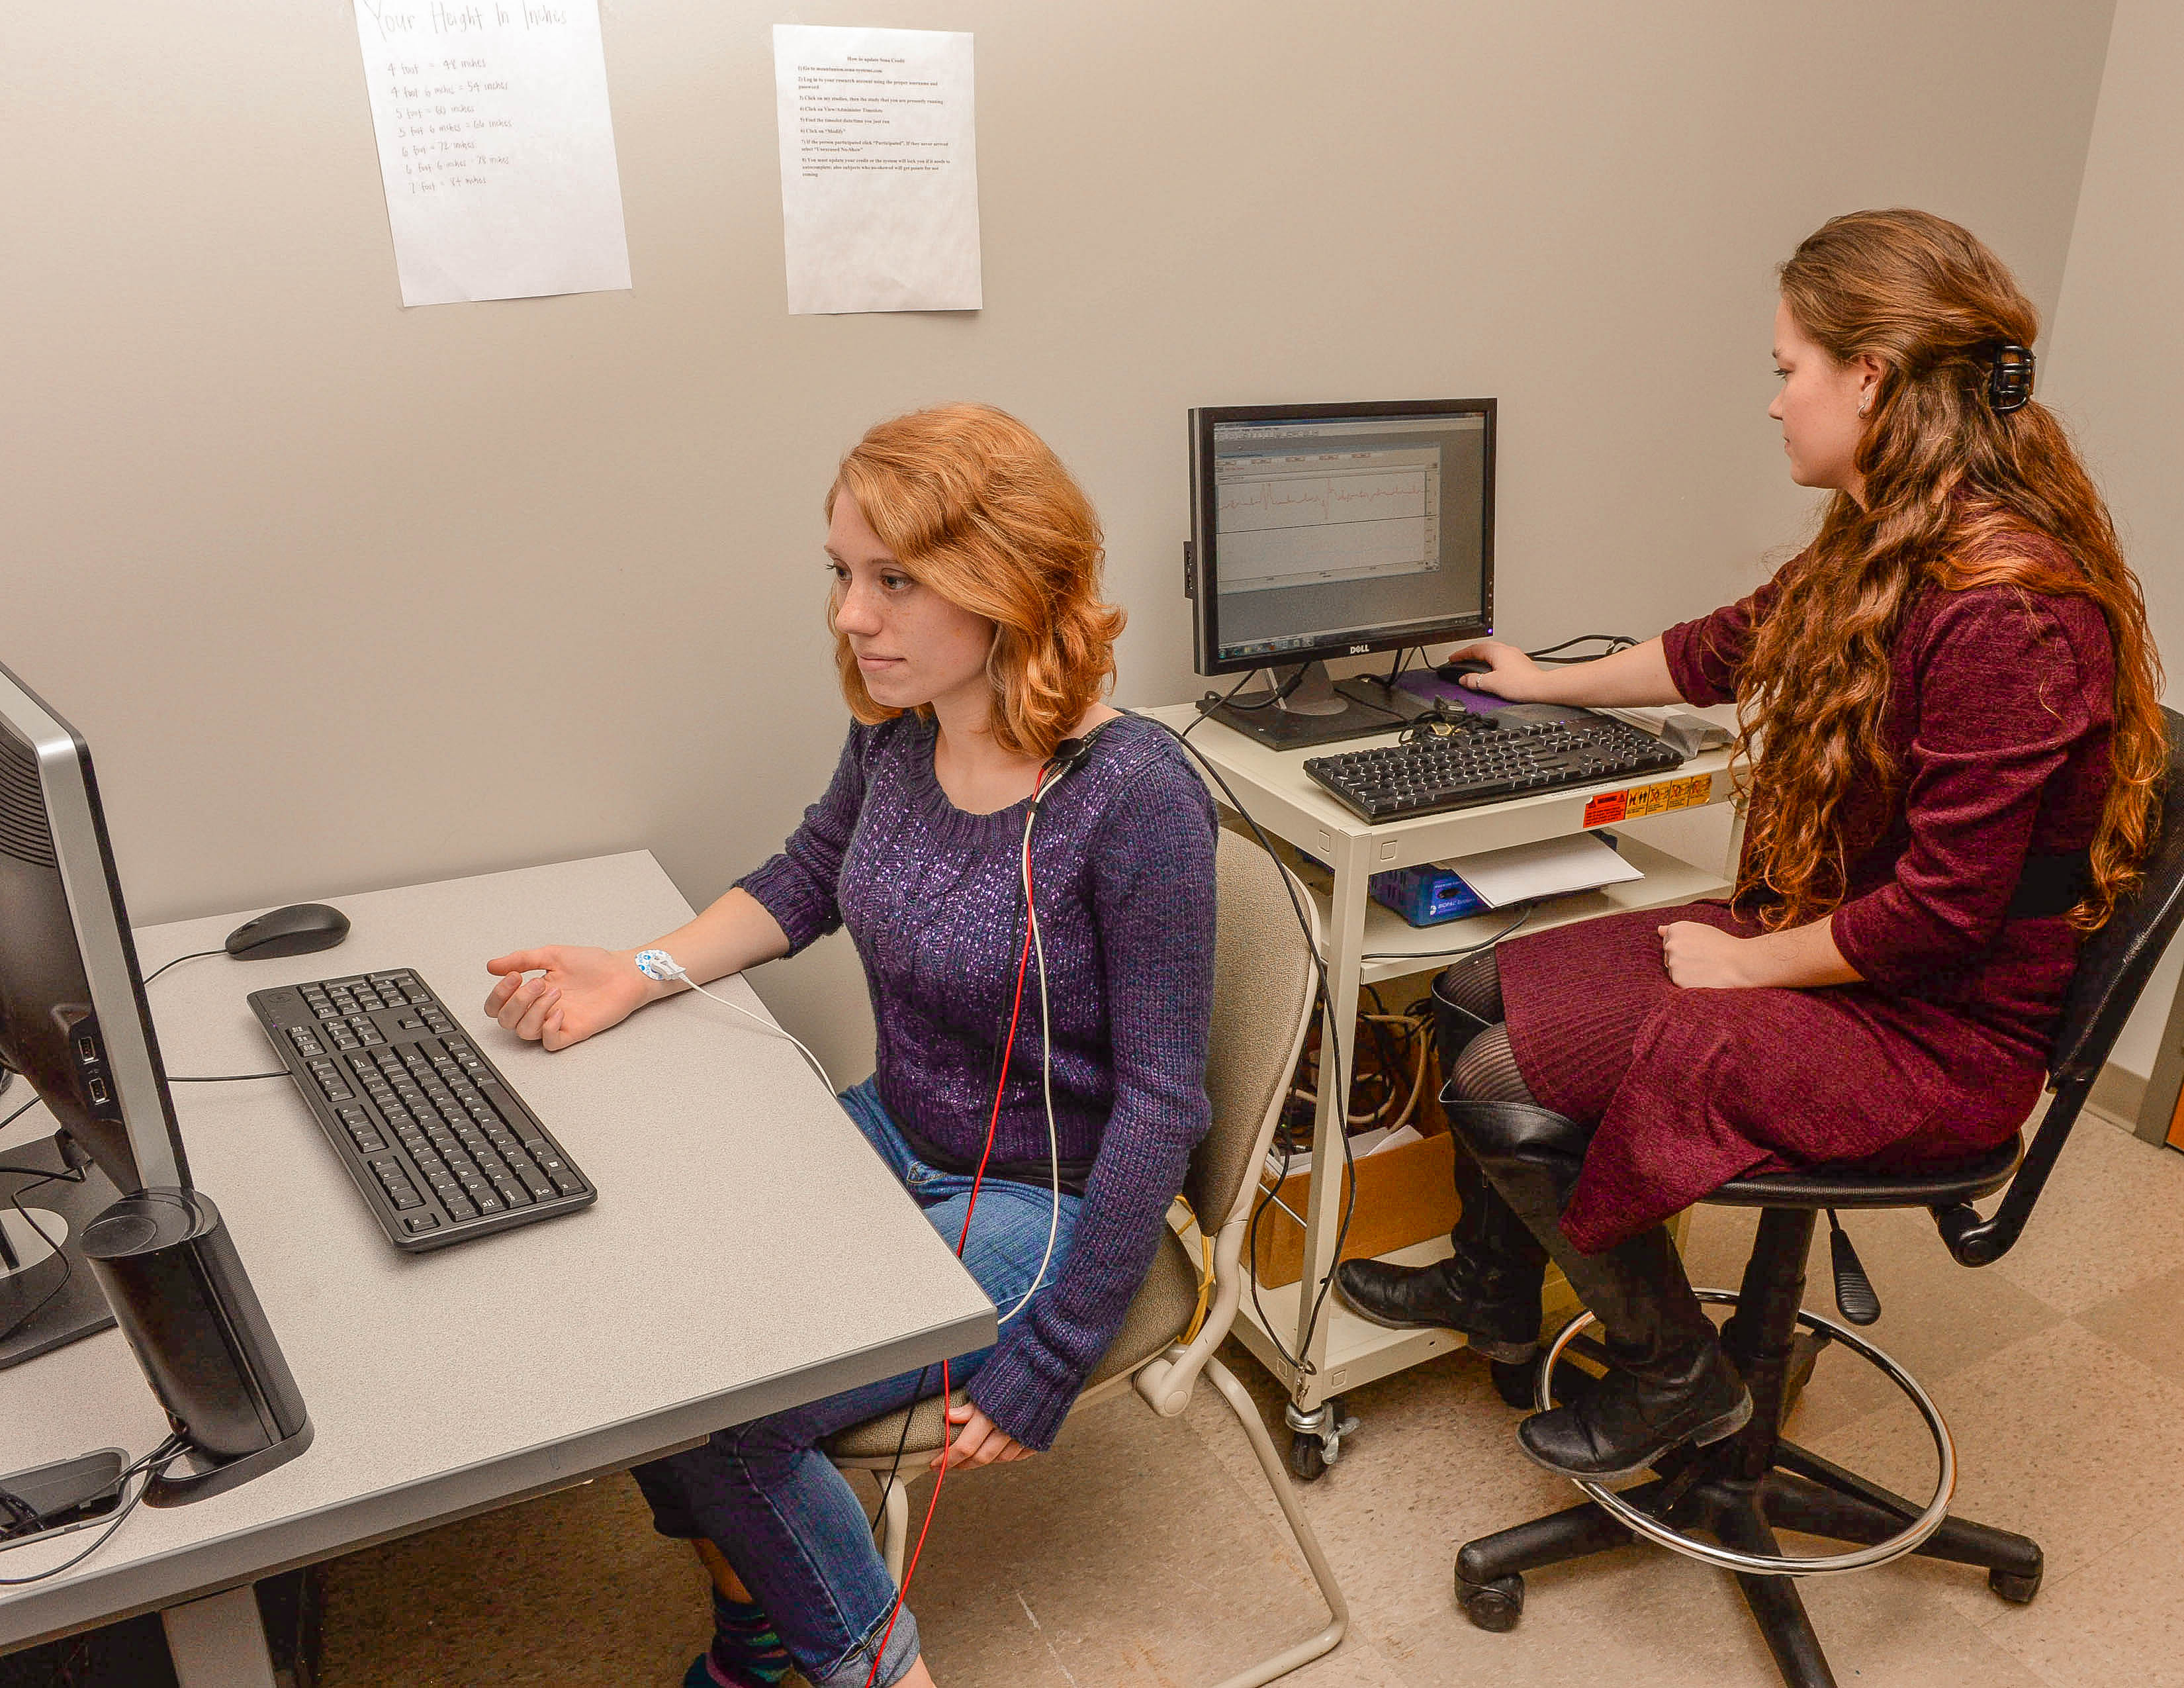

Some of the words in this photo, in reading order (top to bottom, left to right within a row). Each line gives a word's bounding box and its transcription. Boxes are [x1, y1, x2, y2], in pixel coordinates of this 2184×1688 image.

[363, 0, 416, 42] Your
[430, 1, 482, 33] Height
[494, 1, 510, 26] In
[521, 0, 567, 30] Inches
[388, 64, 395, 77] 4
[391, 86, 398, 99] 4
[1350, 644, 1369, 655] DELL
